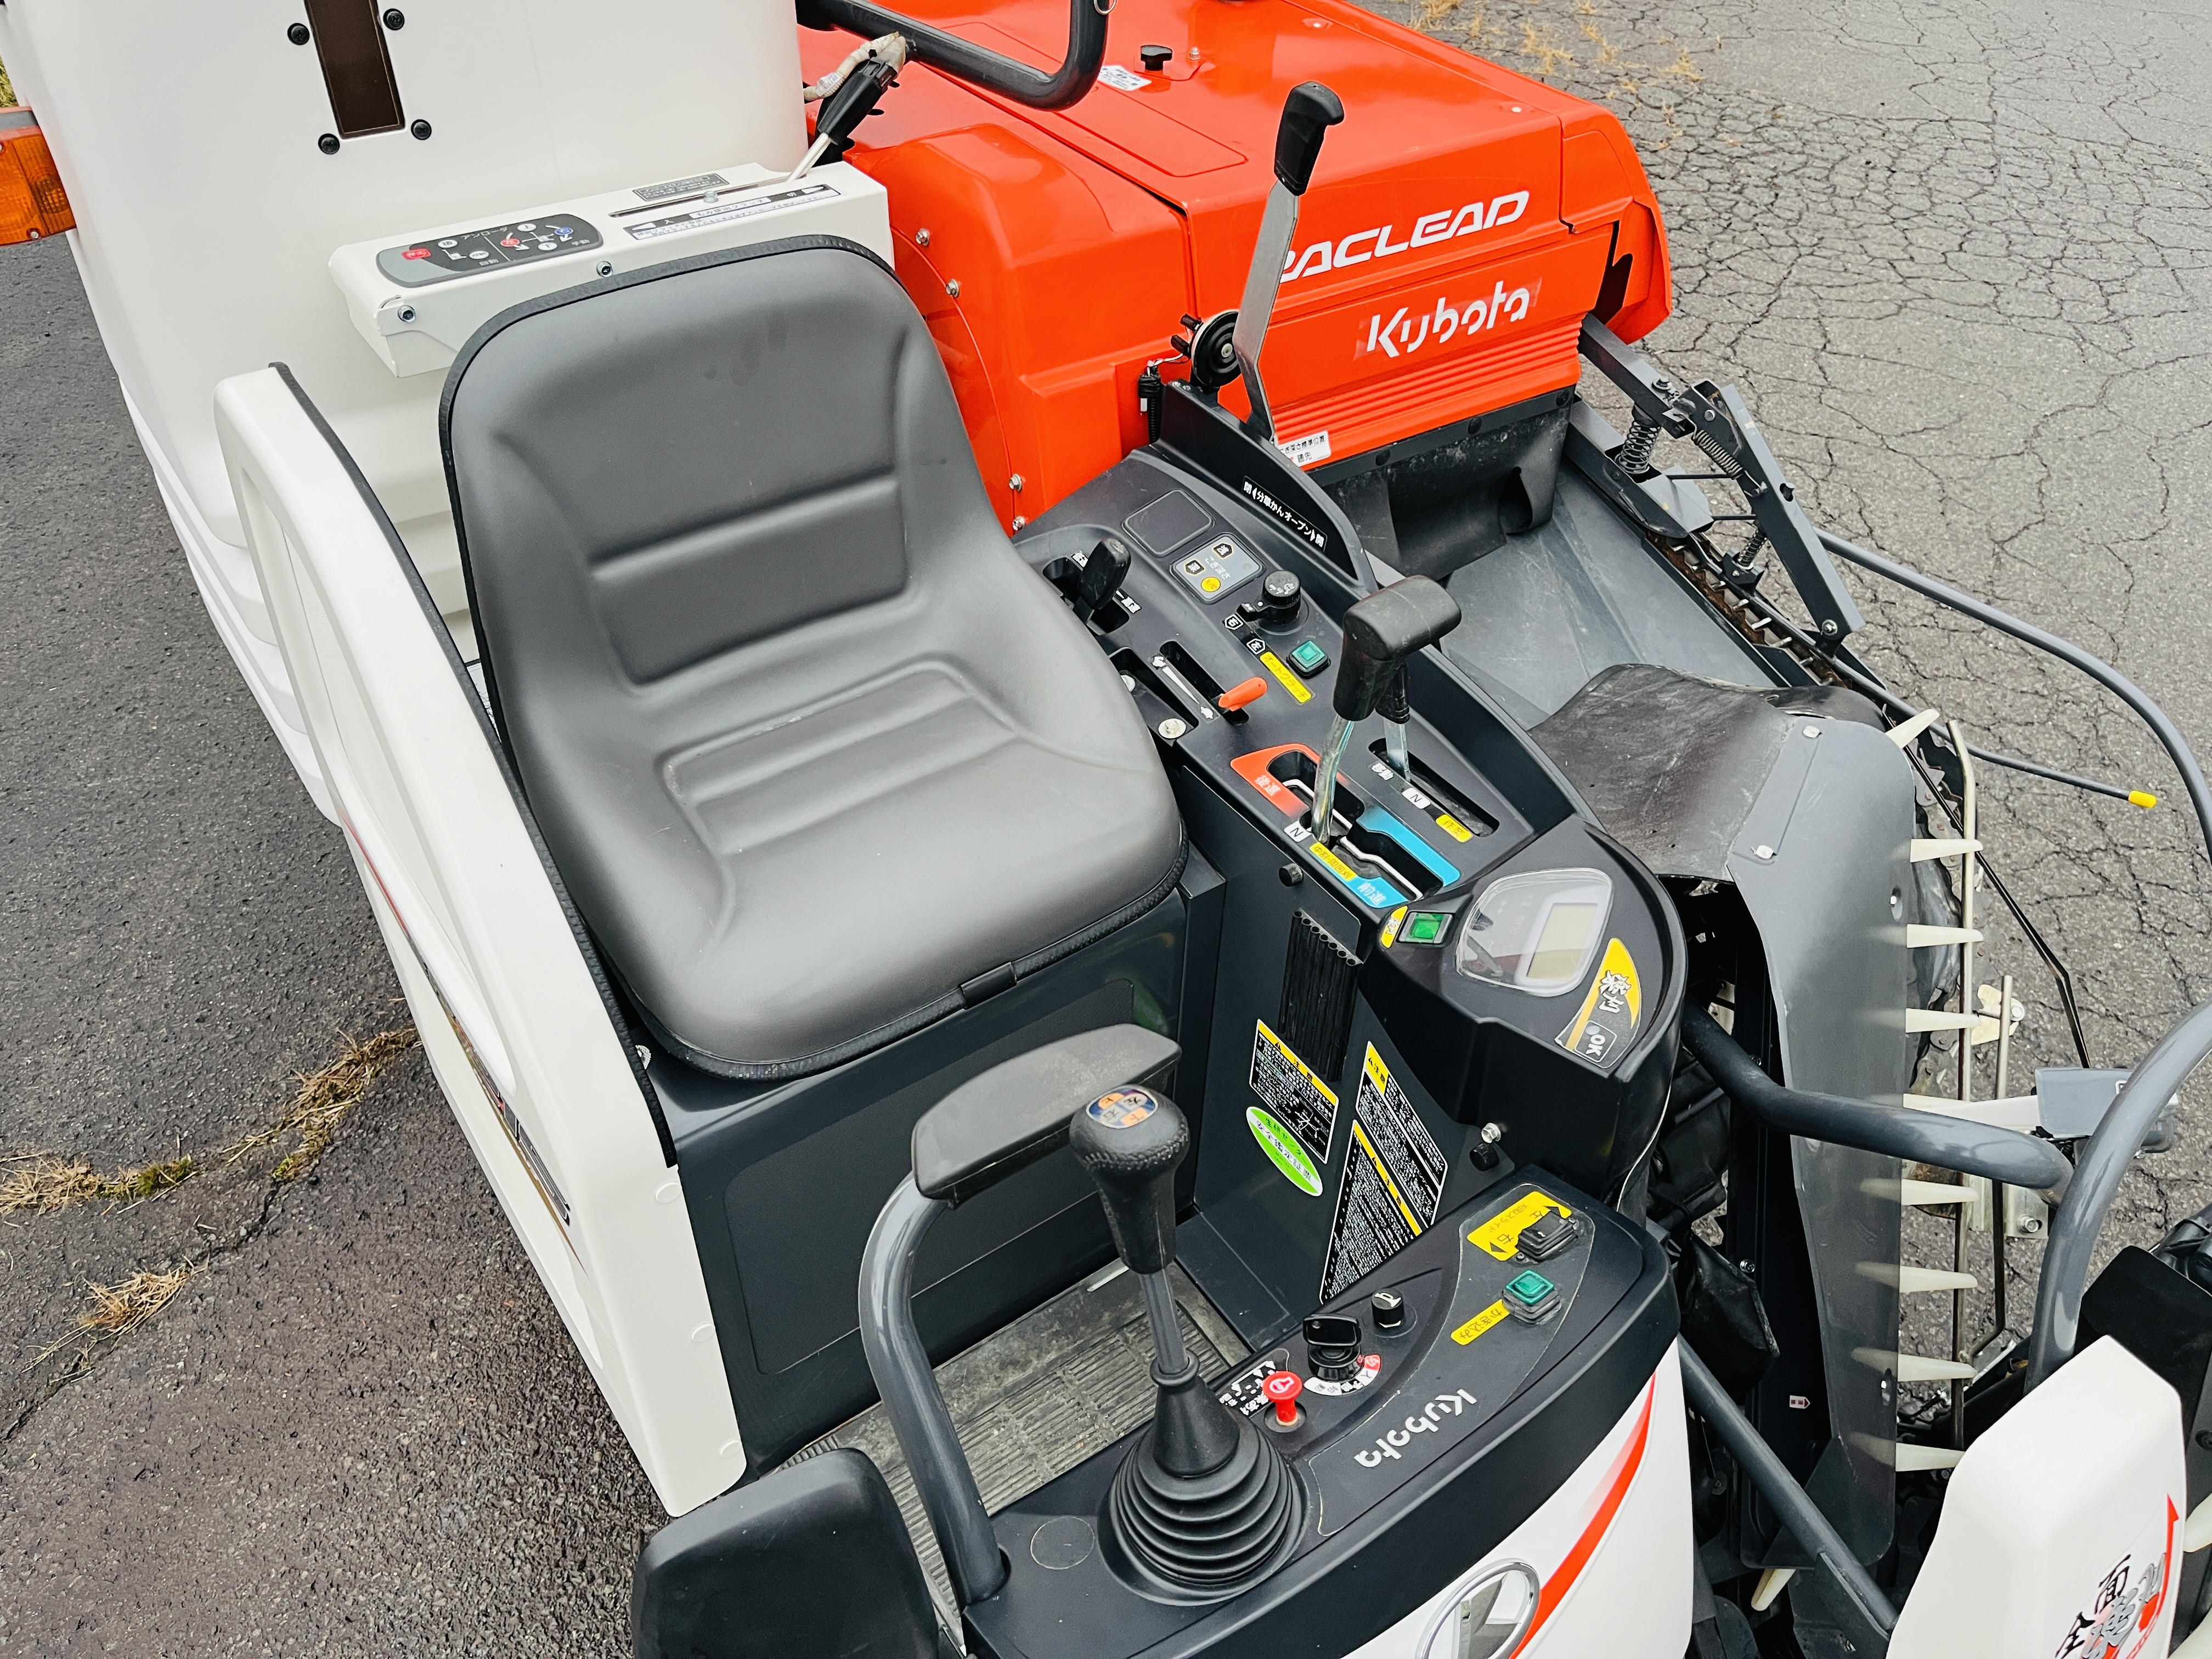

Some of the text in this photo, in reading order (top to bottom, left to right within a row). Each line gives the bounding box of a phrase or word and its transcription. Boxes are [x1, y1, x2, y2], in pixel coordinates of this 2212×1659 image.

[1366, 279, 1532, 358] Kubota
[1263, 654, 1309, 698] オートクラッチ
[1254, 774, 1282, 797] 後進
[1409, 794, 1423, 803] N
[1289, 827, 1304, 838] N
[1357, 881, 1387, 907] 前進
[1585, 1034, 1606, 1057] OK
[1495, 1233, 1513, 1245] 右
[1459, 1307, 1504, 1341] かき込み
[1353, 1388, 1477, 1468] Kubota
